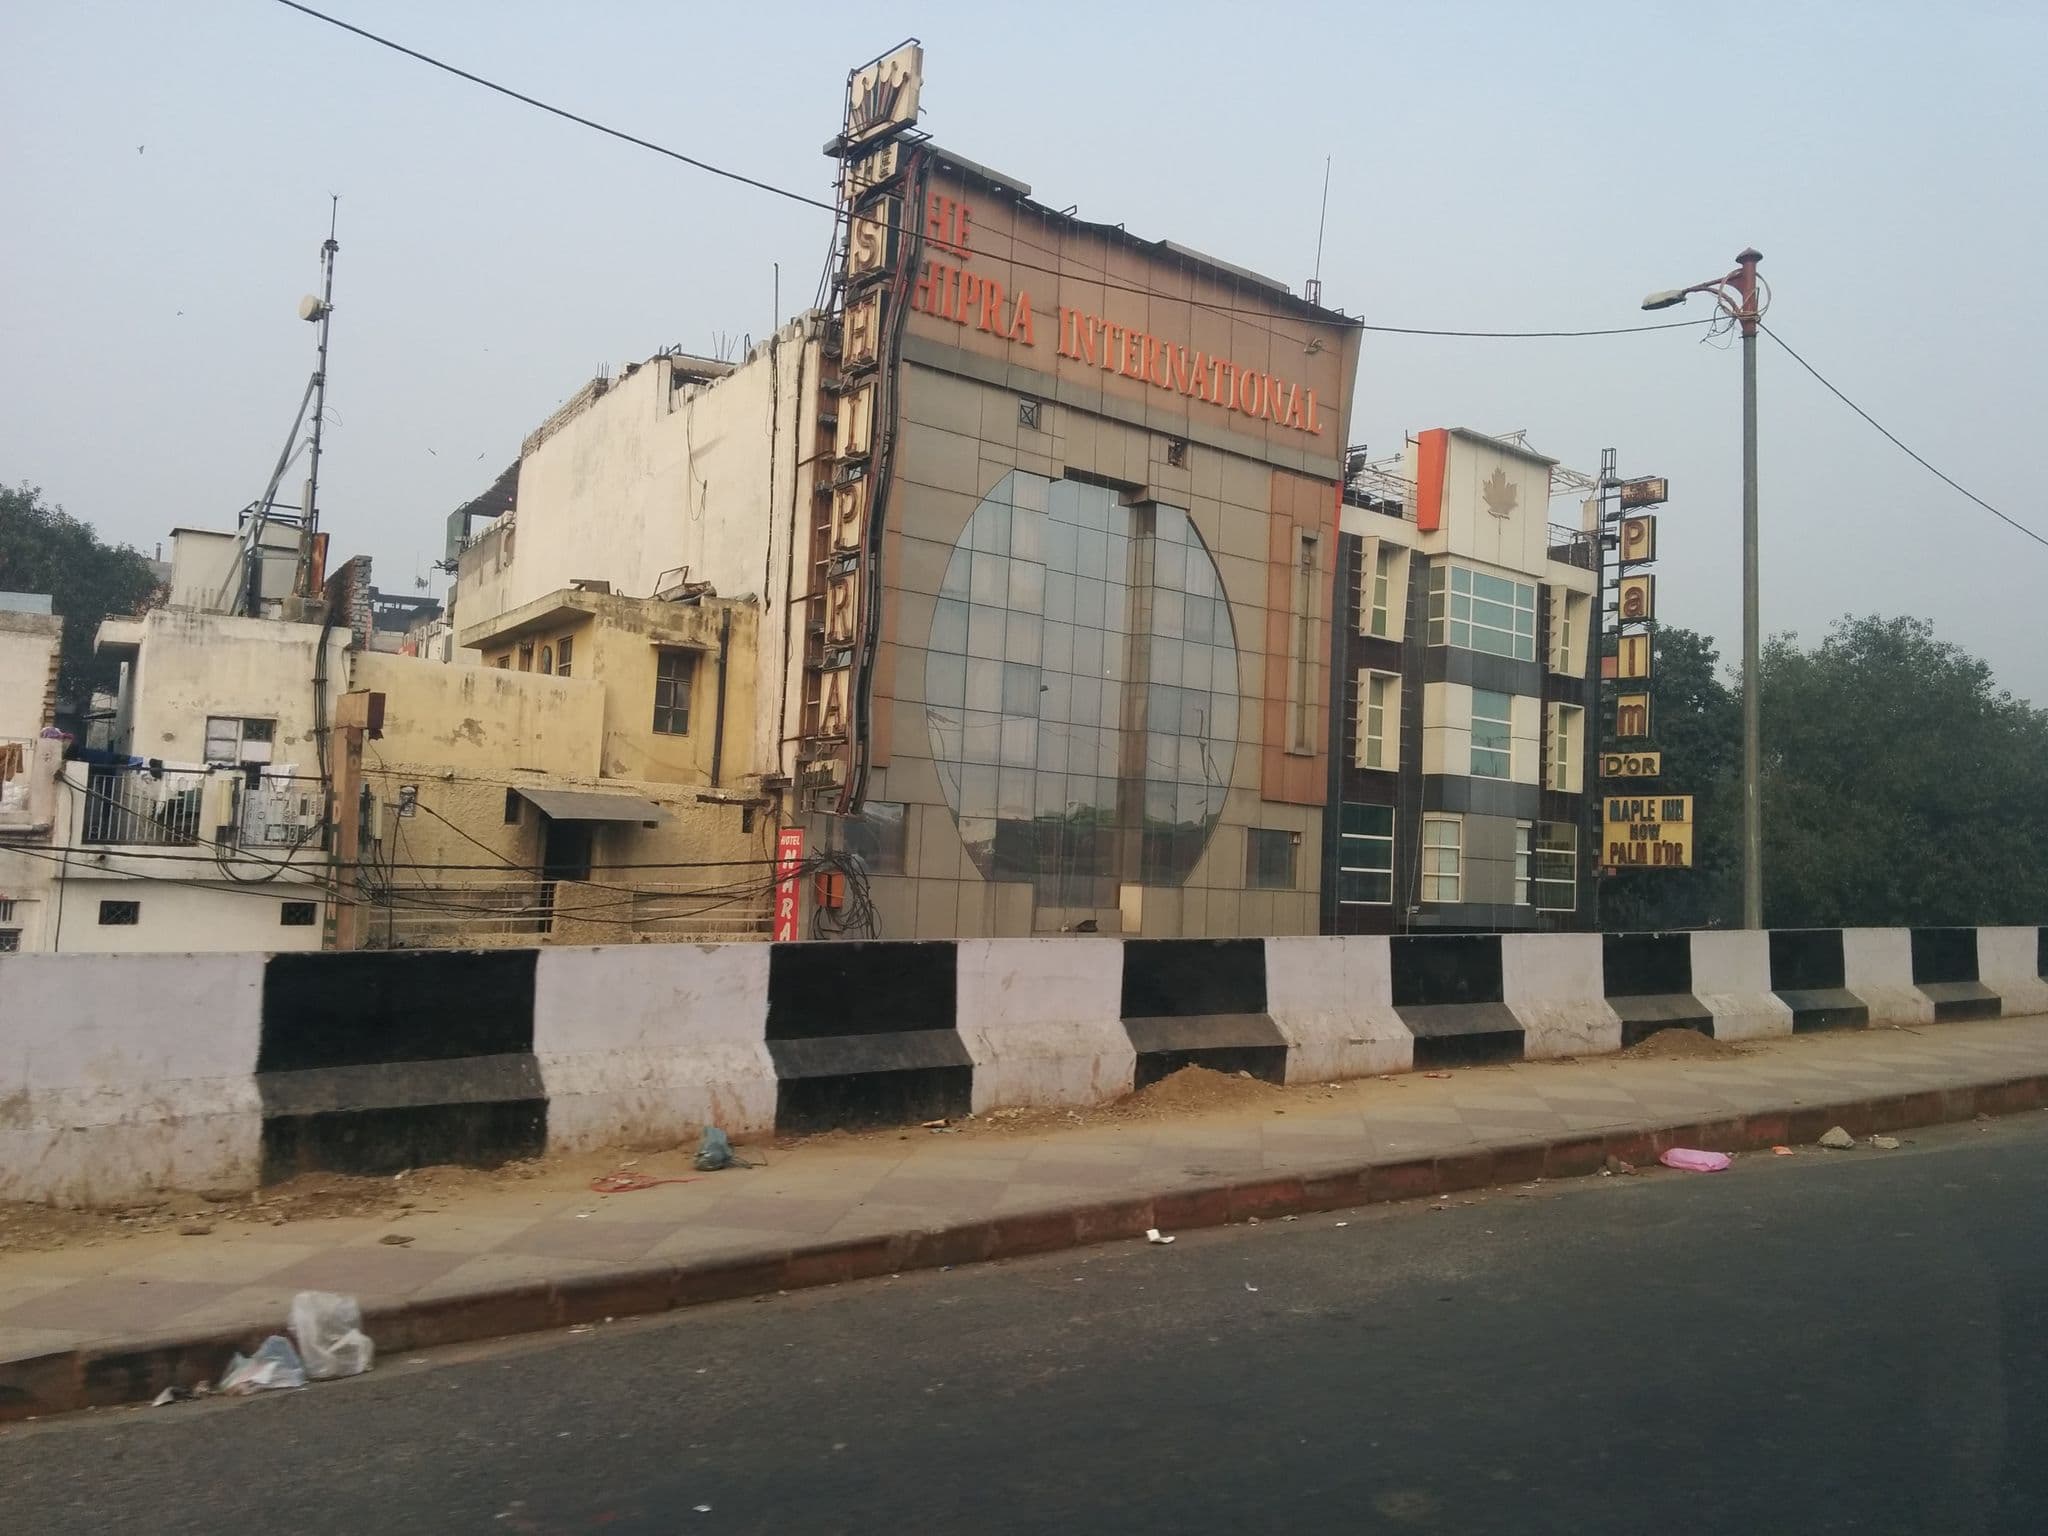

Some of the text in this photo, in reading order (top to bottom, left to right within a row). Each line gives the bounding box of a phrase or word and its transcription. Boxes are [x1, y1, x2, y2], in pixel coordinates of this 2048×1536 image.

[922, 190, 975, 262] HE
[911, 260, 1323, 436] HIPRA INTERNATIONAL
[1605, 755, 1657, 776] D'OR
[1609, 798, 1685, 822] MAPLE INN
[780, 834, 801, 846] HOTEL
[1629, 823, 1662, 841] NOW
[1609, 839, 1684, 865] PALM D'OR
